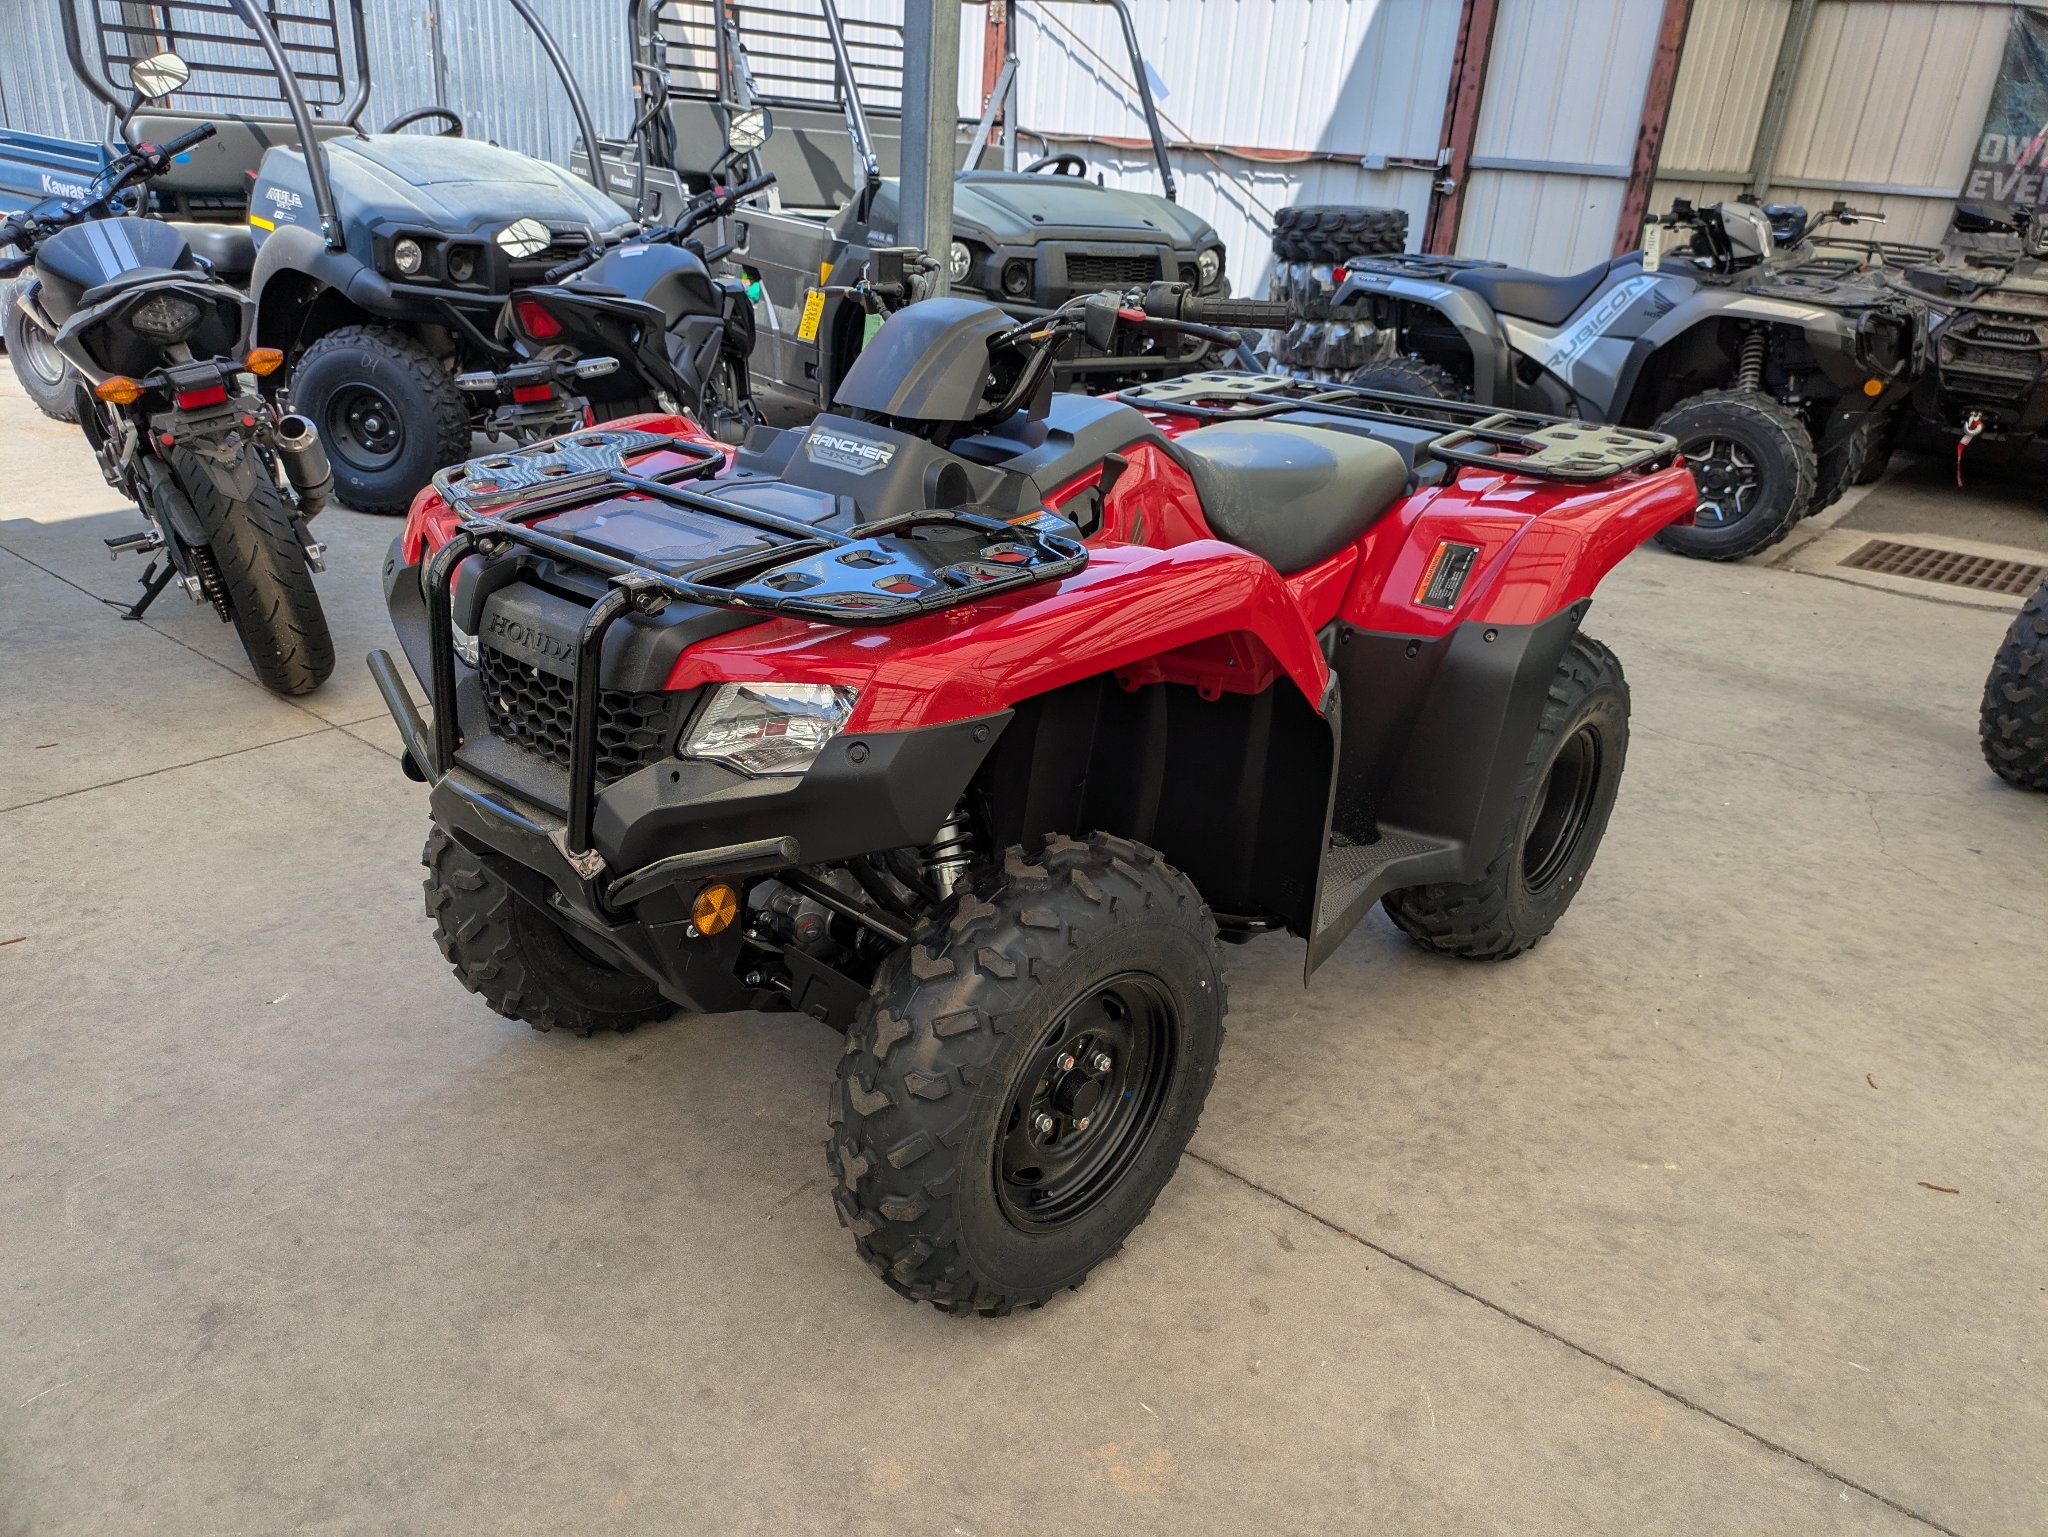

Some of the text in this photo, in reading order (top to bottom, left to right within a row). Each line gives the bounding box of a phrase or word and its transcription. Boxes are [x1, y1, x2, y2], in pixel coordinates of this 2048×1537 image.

[41, 174, 85, 200] Kawas
[266, 187, 303, 208] MULE
[1545, 278, 1645, 367] RUBICON
[808, 434, 893, 464] RANCHER
[488, 612, 577, 666] HONDA
